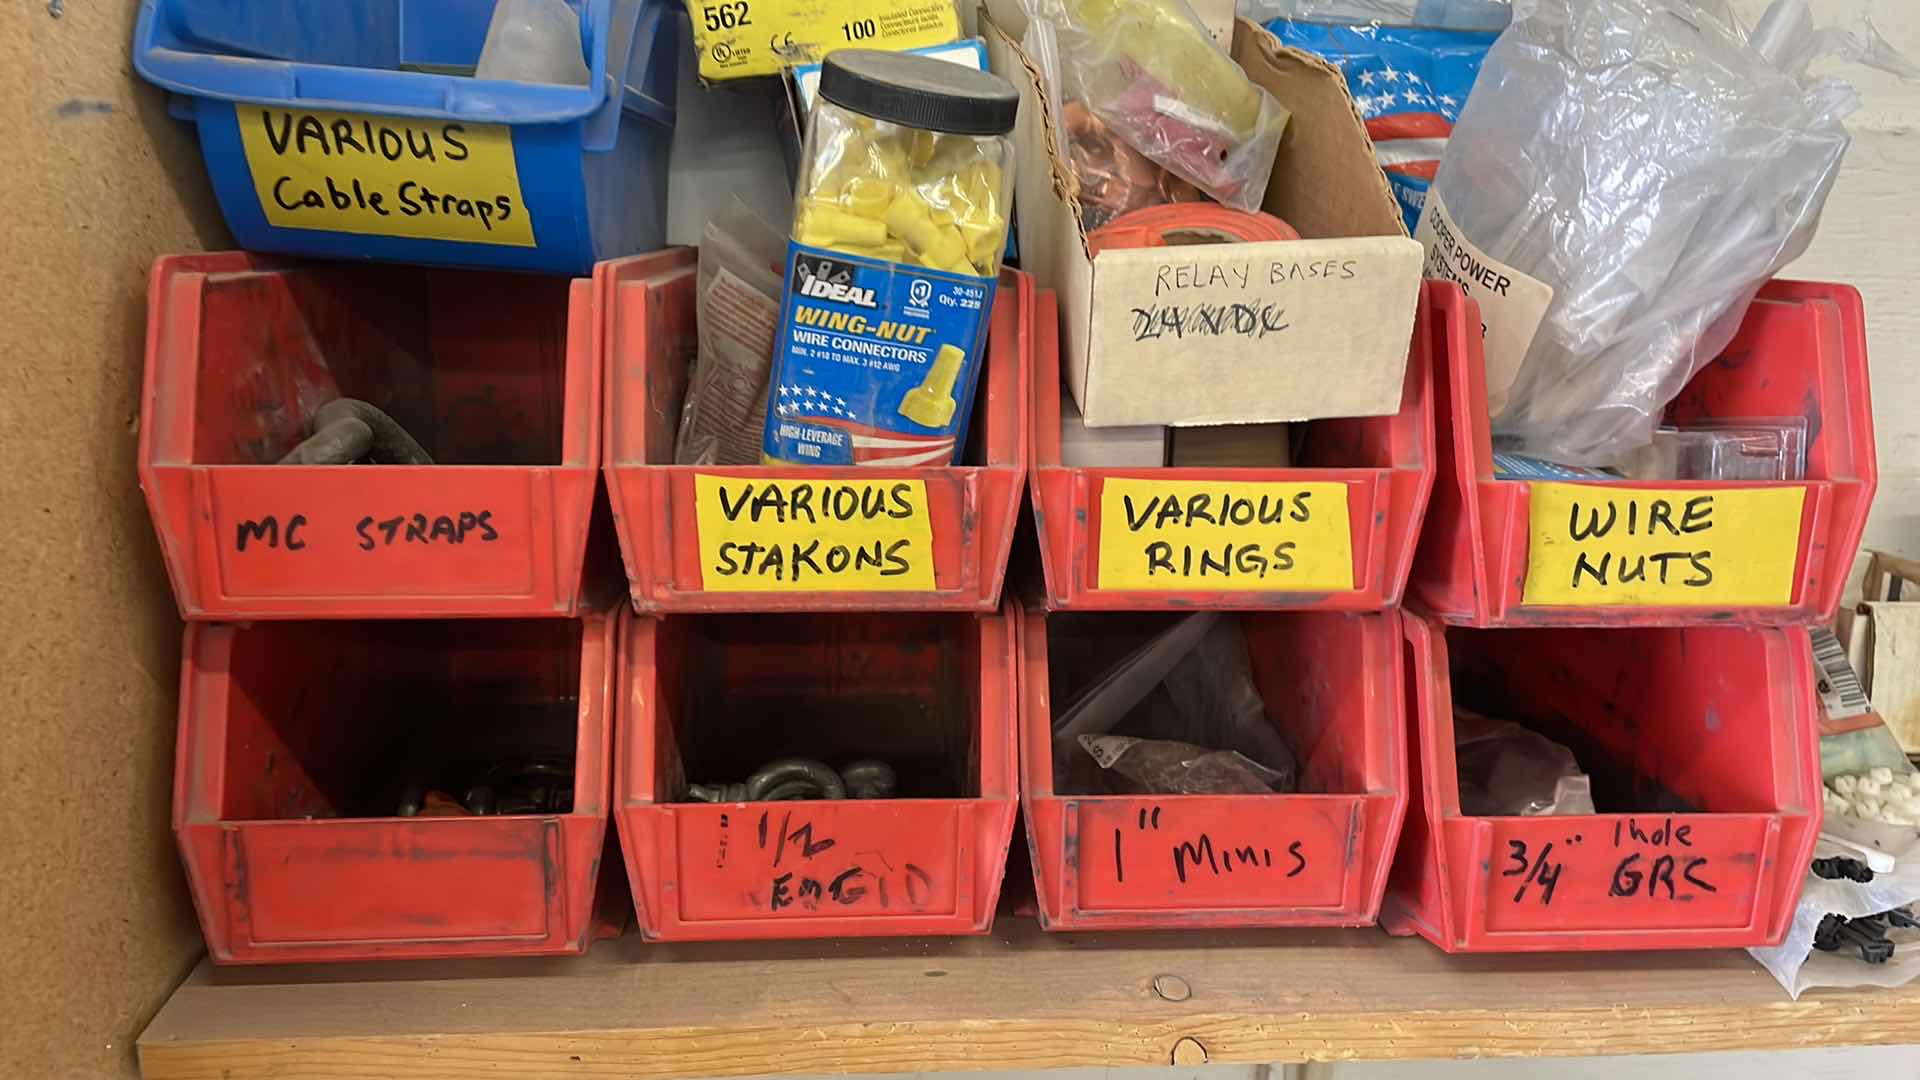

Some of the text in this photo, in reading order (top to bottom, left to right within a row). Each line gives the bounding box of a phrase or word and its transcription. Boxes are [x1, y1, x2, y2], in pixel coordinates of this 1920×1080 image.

[703, 1, 752, 32] 562
[842, 18, 876, 42] 100
[262, 110, 468, 162] VARIOUS
[273, 176, 512, 231] Cable Straps
[1429, 206, 1512, 297] COOPER POWER
[800, 275, 877, 308] IDEAL
[1155, 260, 1357, 297] RELAY BASES
[792, 330, 928, 365] WIRE CONNECTORS
[831, 352, 842, 363] TO
[779, 423, 844, 448] HIGH-LEVERAGE
[797, 442, 822, 458] WING
[719, 483, 913, 524] VARIOUS
[1123, 491, 1312, 532] VARIOUS
[1569, 496, 1713, 542] WIRE
[236, 510, 499, 552] MC STRAPS
[715, 539, 911, 582] STAKONS
[1144, 541, 1296, 578] RINGS
[1572, 551, 1713, 588] NUTS
[1608, 853, 1717, 900] GRC
